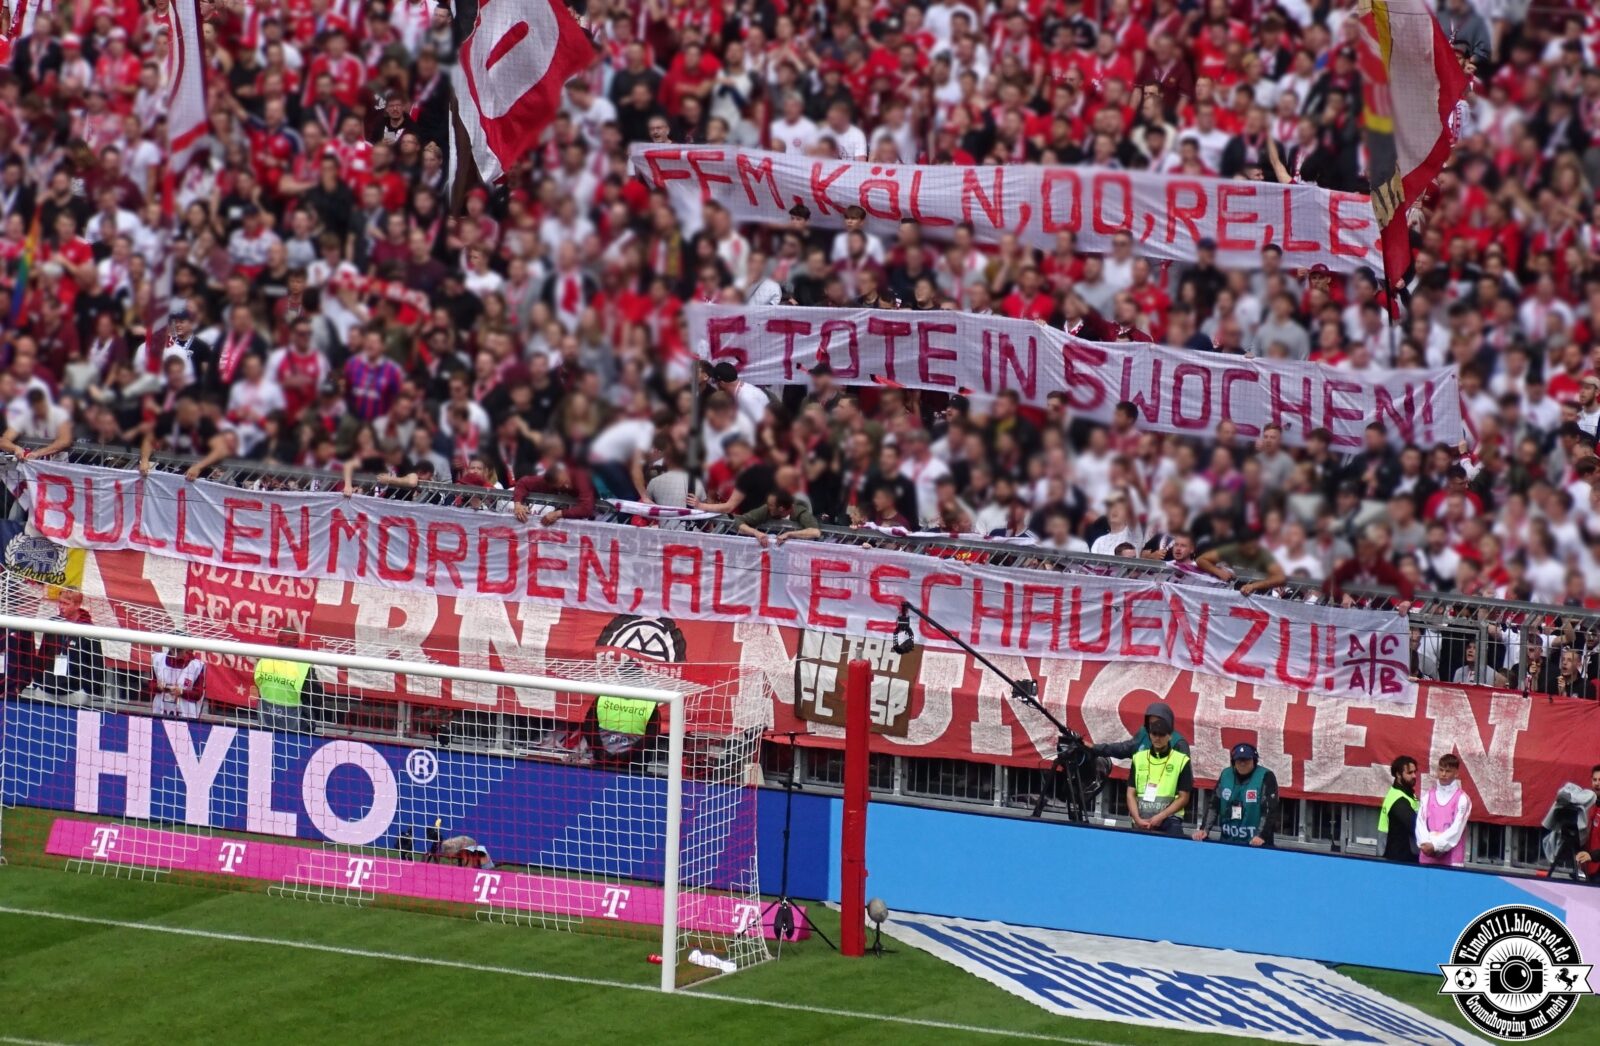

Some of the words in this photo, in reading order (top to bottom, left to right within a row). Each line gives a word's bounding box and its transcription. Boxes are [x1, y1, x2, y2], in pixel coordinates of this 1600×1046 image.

[765, 316, 957, 386] TOTE
[981, 329, 1037, 399] IN
[1062, 341, 1107, 410] 5
[1120, 356, 1435, 446] WOCHEN!
[34, 472, 311, 571] BULLEN
[325, 507, 645, 612] MORDEN,
[660, 543, 852, 628] ALLE
[865, 564, 1210, 665] SCHAUEN
[1222, 605, 1337, 691] ZU!
[187, 586, 311, 645] GEGEN
[603, 700, 647, 717] Steward
[74, 710, 398, 846] HYLO
[1222, 823, 1256, 838] HOST
